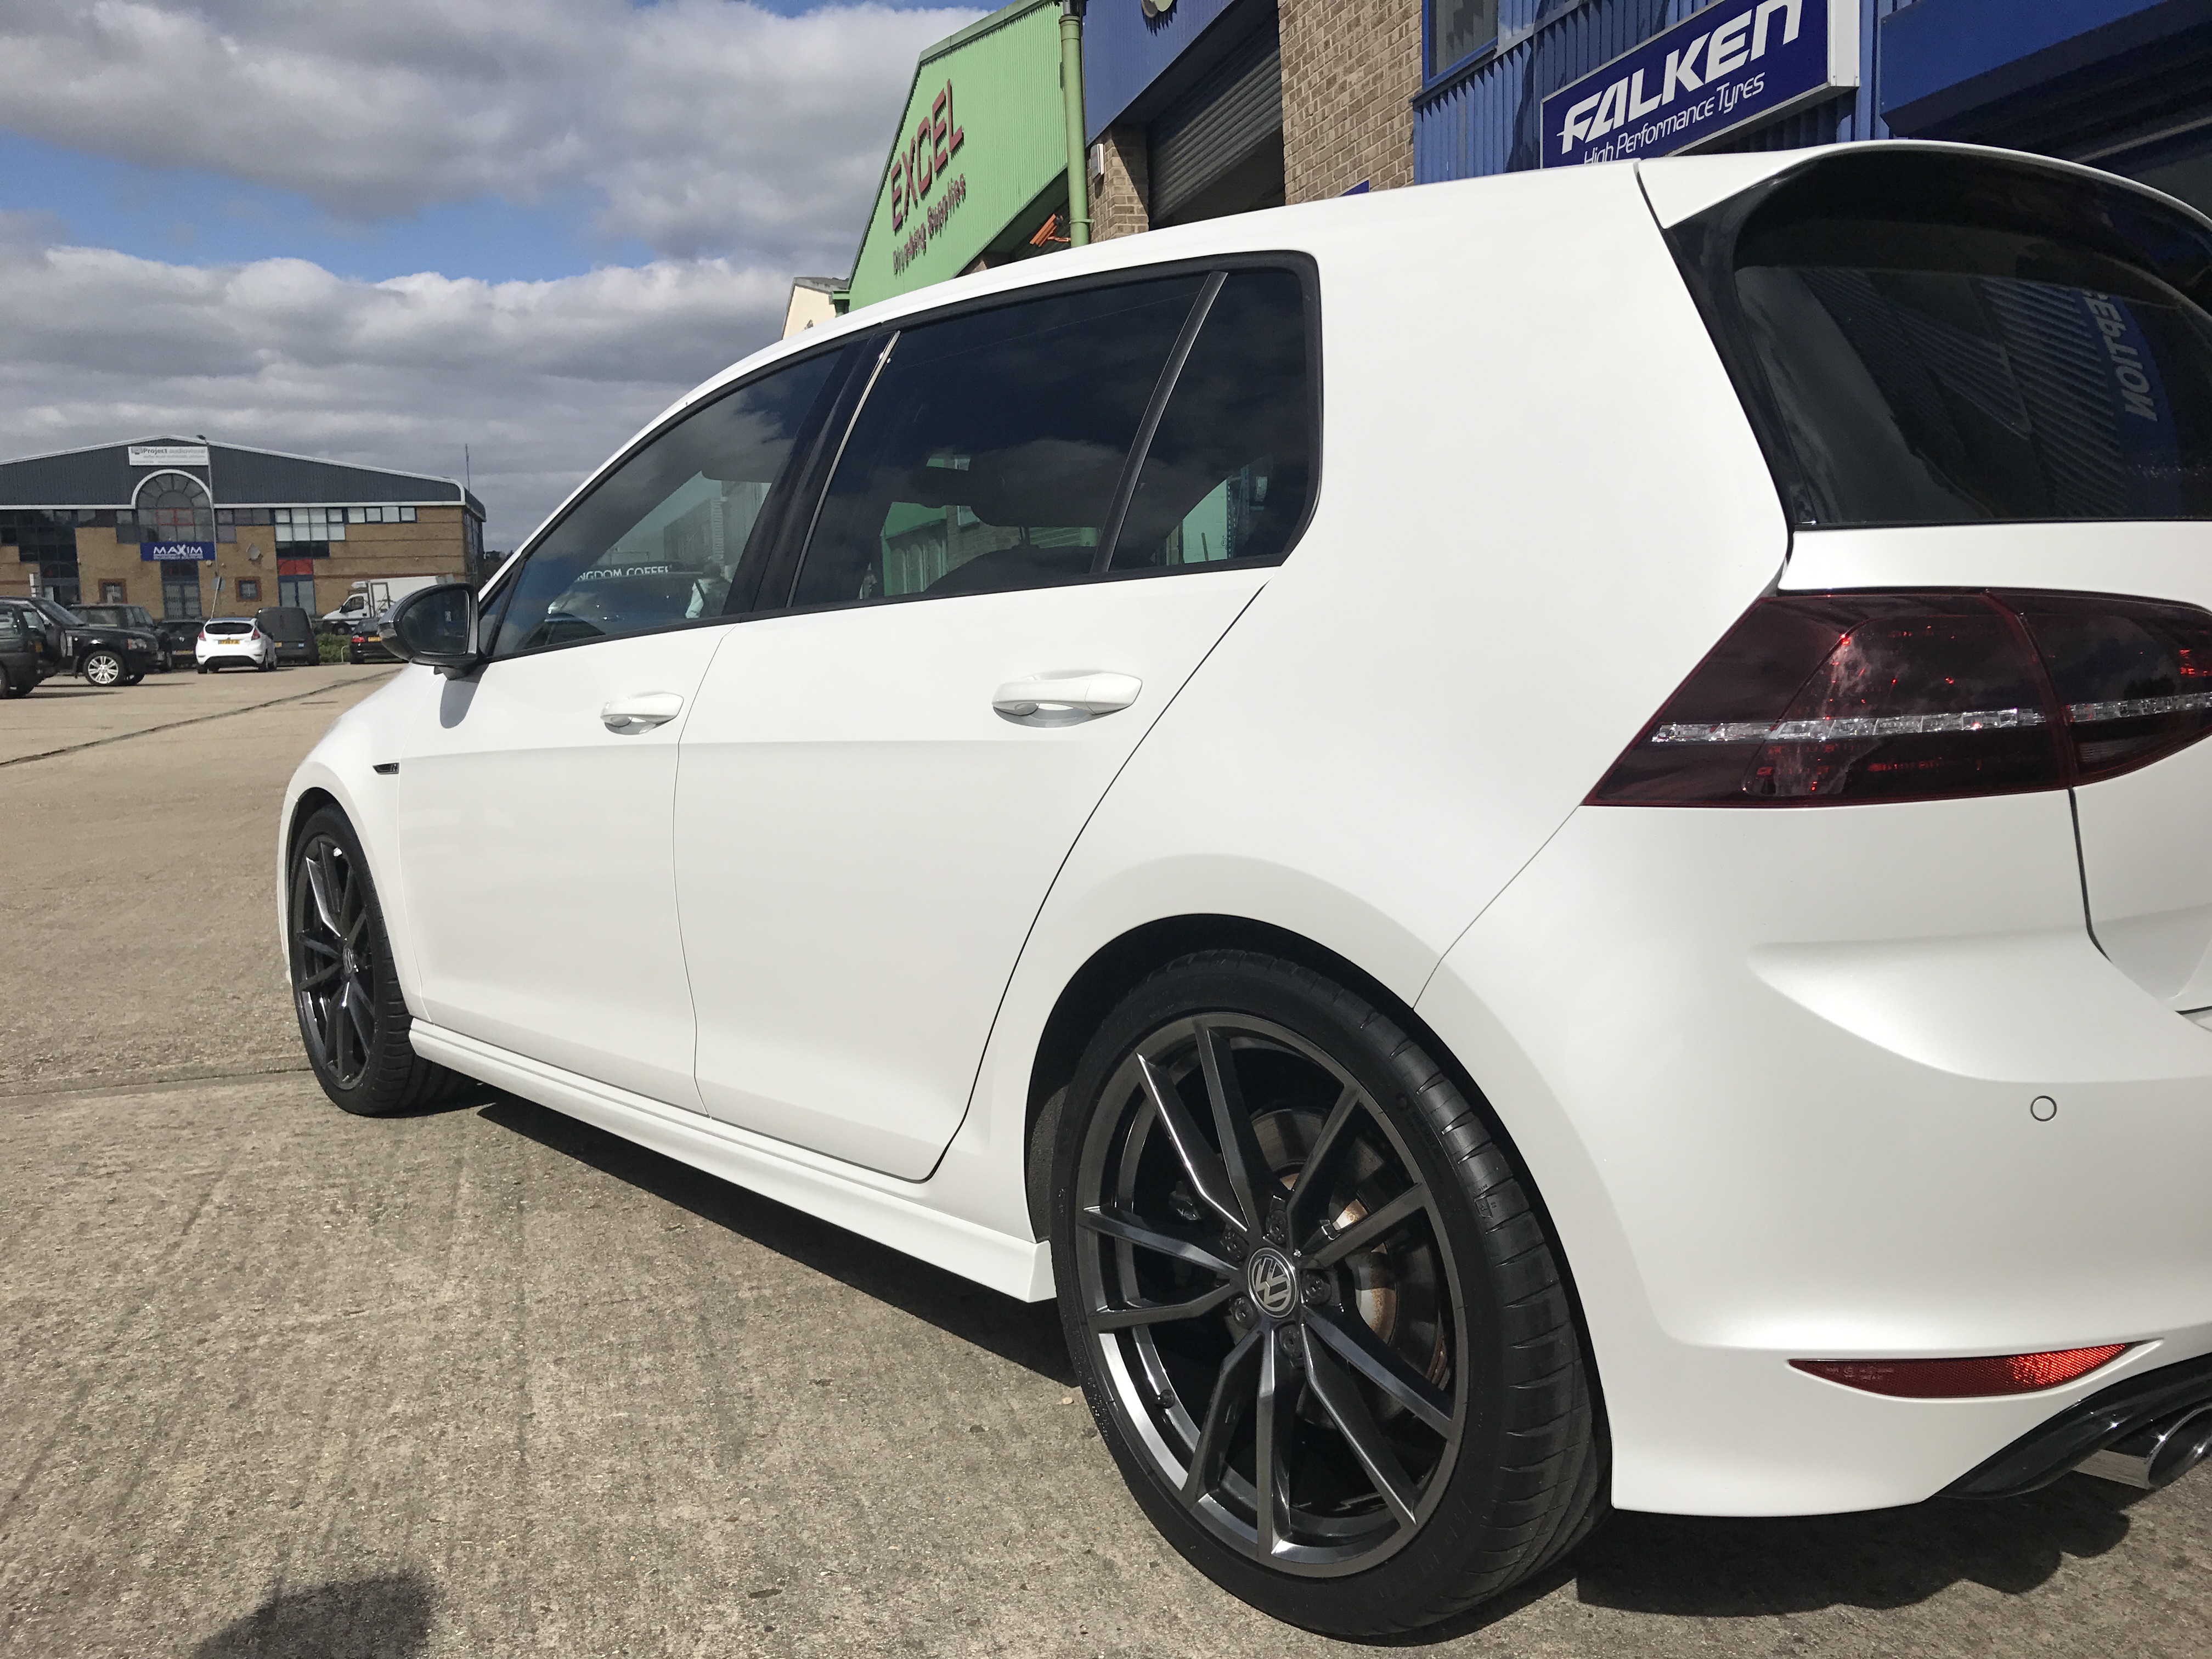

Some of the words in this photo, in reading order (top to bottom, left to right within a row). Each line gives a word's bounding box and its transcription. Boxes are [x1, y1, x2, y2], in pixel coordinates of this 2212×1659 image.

[1556, 0, 1802, 154] FALKEN
[1616, 96, 1716, 159] Performance
[1716, 72, 1765, 114] Tyres
[891, 78, 963, 232] EXCEL
[927, 173, 966, 235] Supplies
[144, 447, 168, 455] Project
[154, 544, 203, 555] MAXIM
